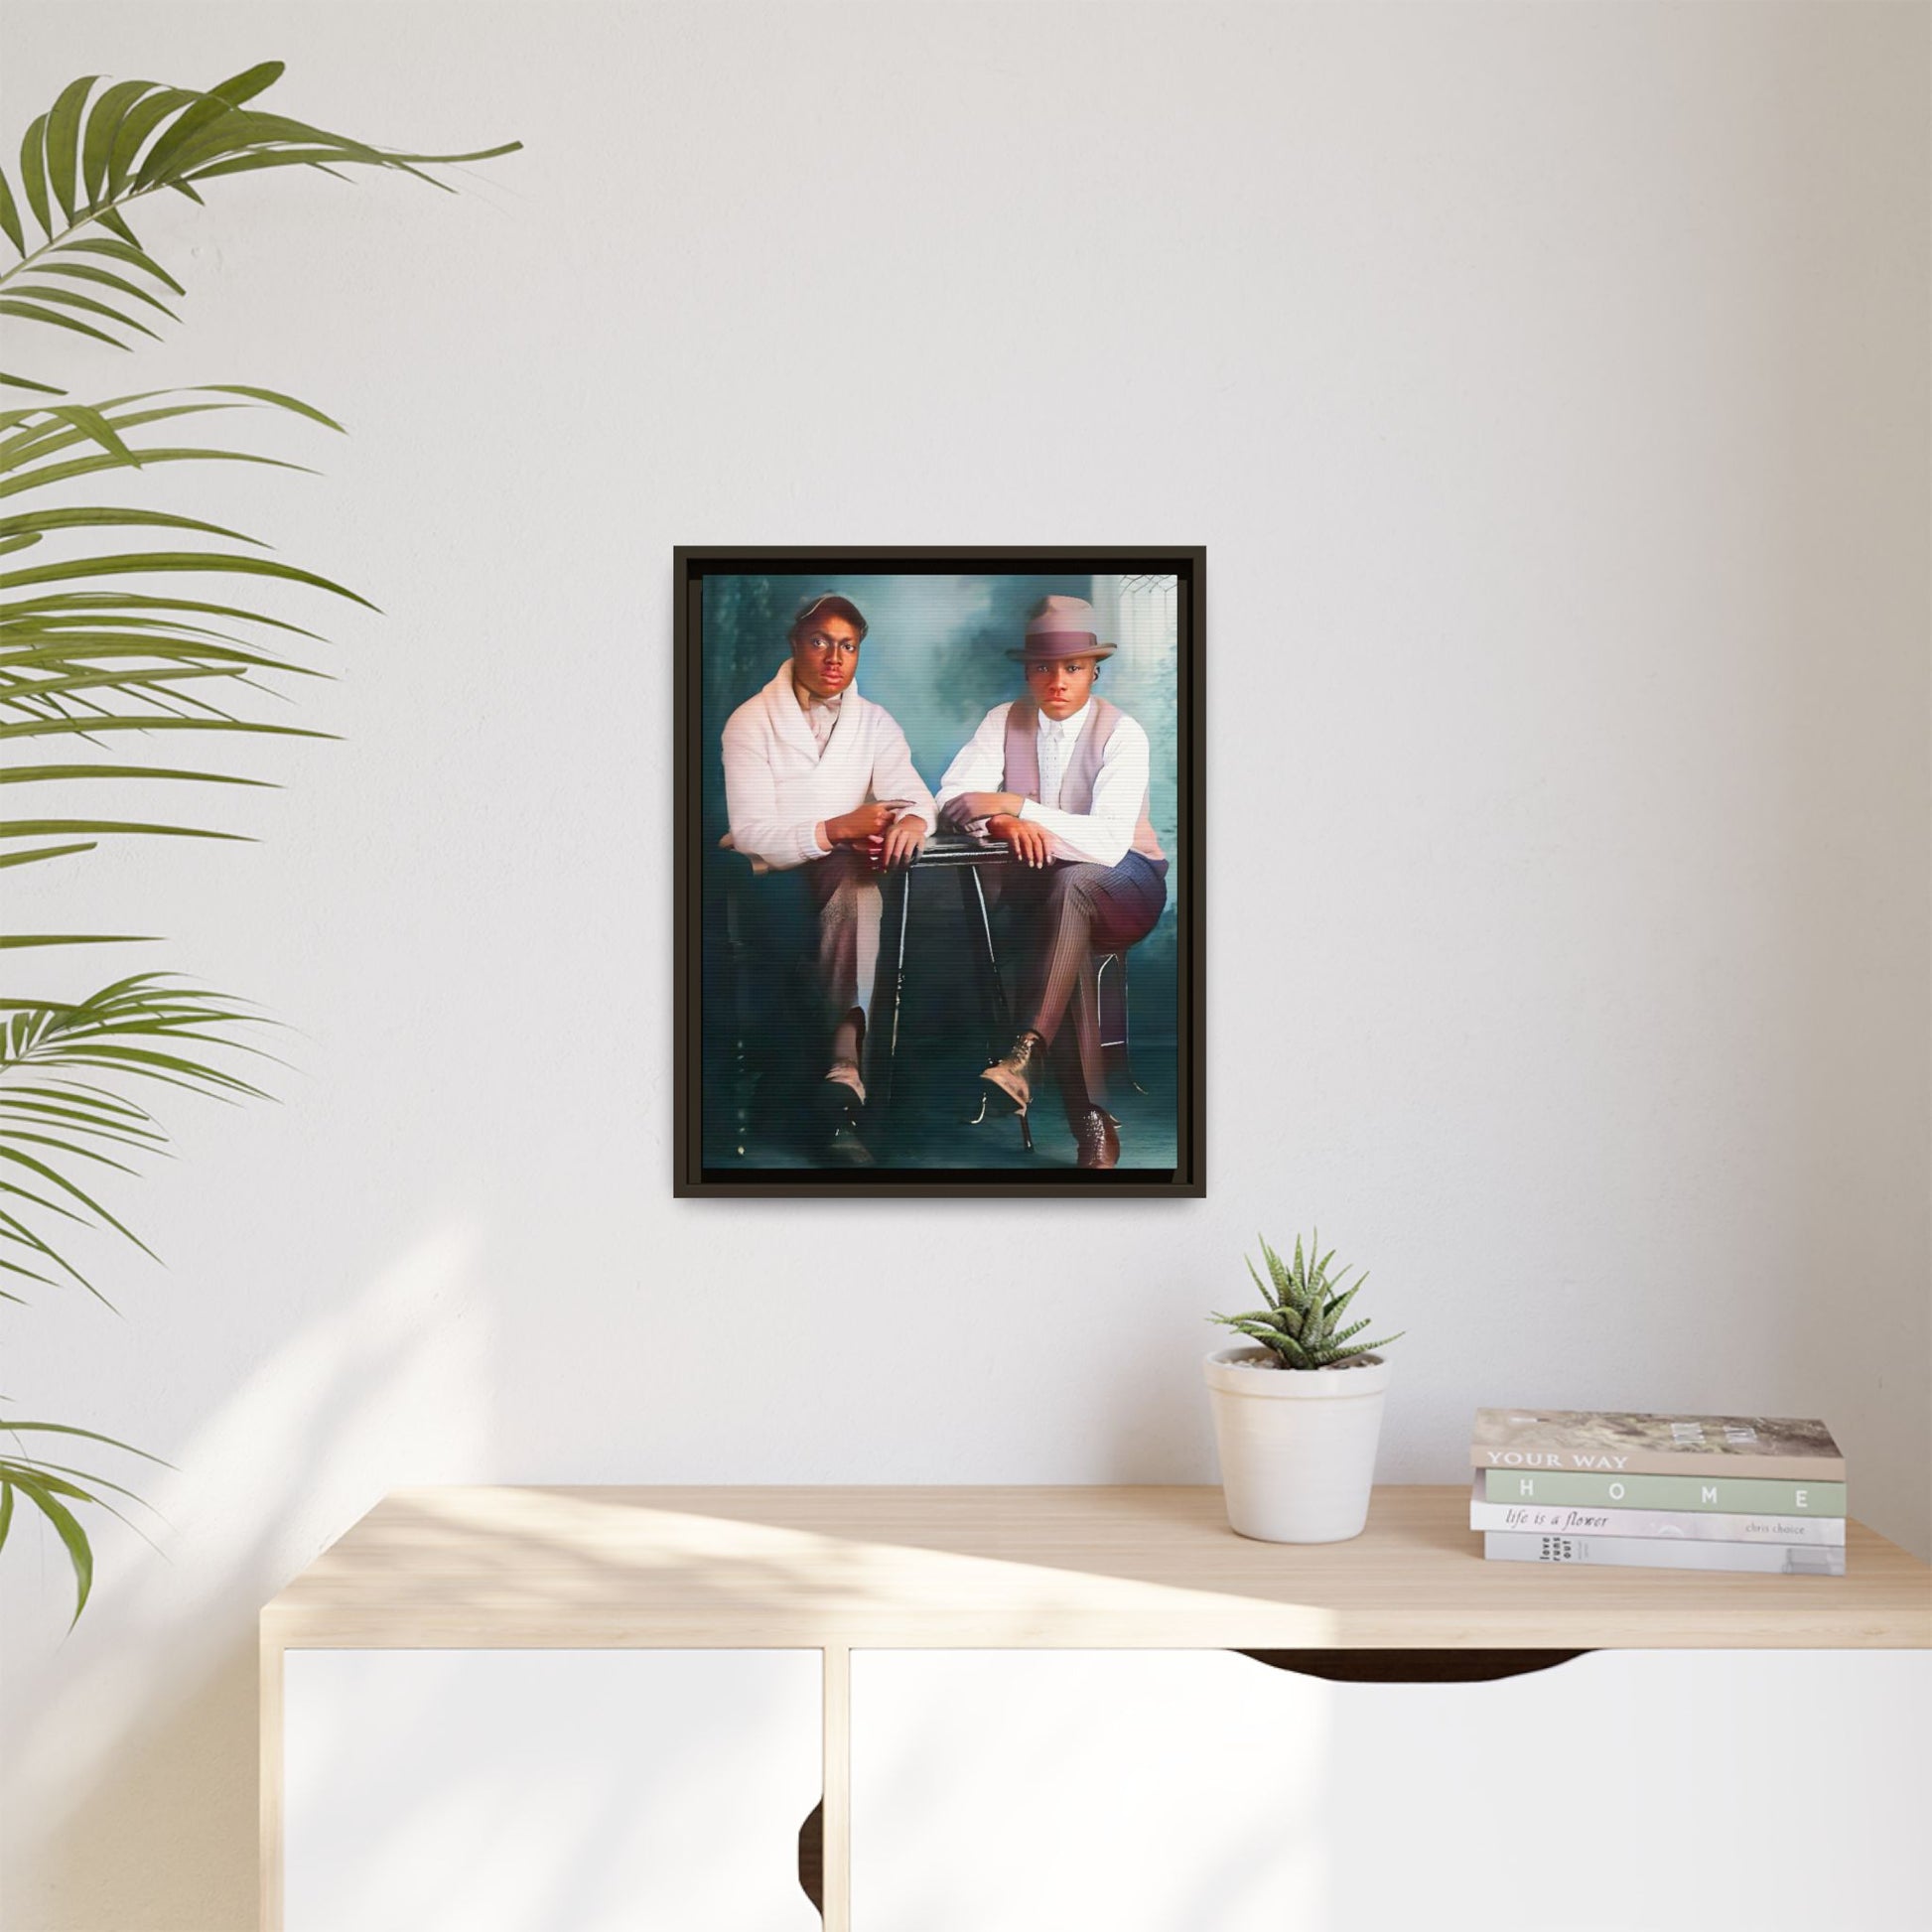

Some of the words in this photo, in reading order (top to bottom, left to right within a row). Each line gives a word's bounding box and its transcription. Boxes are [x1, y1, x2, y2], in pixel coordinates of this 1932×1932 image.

[1487, 1450, 1564, 1467] YOUR
[1572, 1453, 1629, 1469] WAY
[1505, 1508, 1529, 1529] life
[1534, 1511, 1546, 1526] is
[1550, 1515, 1560, 1526] a
[1561, 1510, 1610, 1532] flower
[1772, 1522, 1806, 1535] choice
[1539, 1537, 1551, 1560] love
[1552, 1536, 1562, 1562] runs
[1562, 1540, 1572, 1559] out
